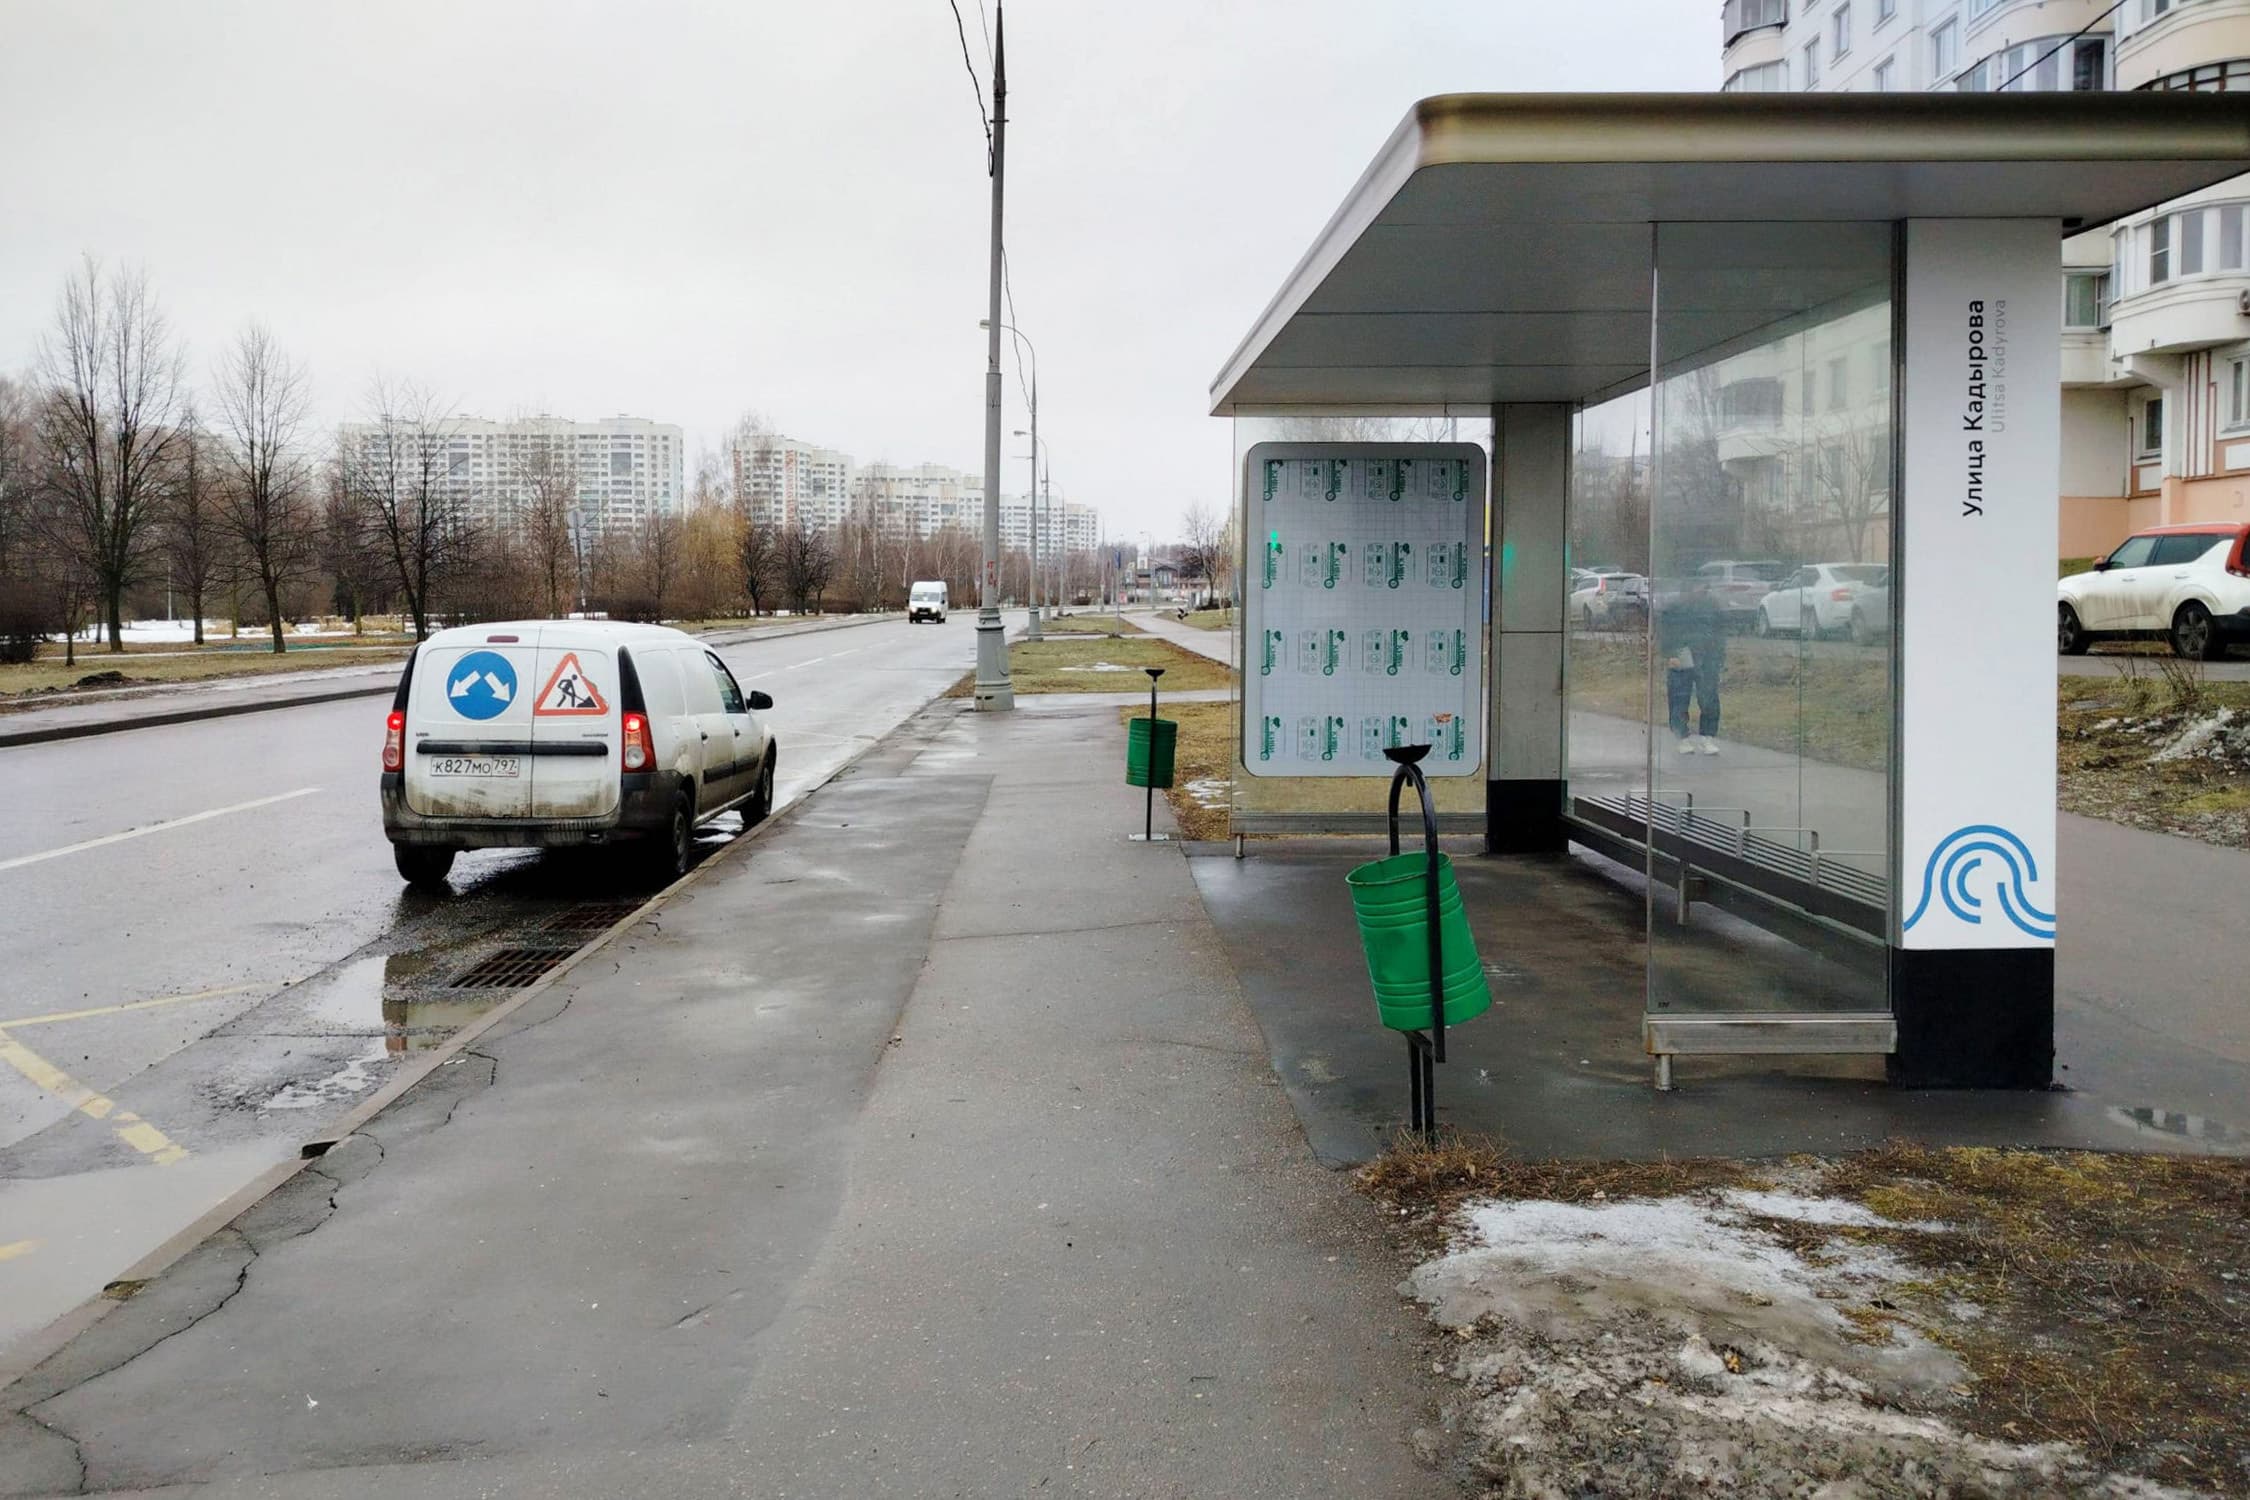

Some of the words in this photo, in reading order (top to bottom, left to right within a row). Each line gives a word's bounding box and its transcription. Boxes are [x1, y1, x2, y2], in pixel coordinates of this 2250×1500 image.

[1963, 300, 1988, 430] Кадырова
[1991, 299, 2008, 378] Kadyrova
[1991, 384, 2006, 433] Ulitsa
[1962, 440, 1986, 516] Улица
[494, 759, 515, 771] 797
